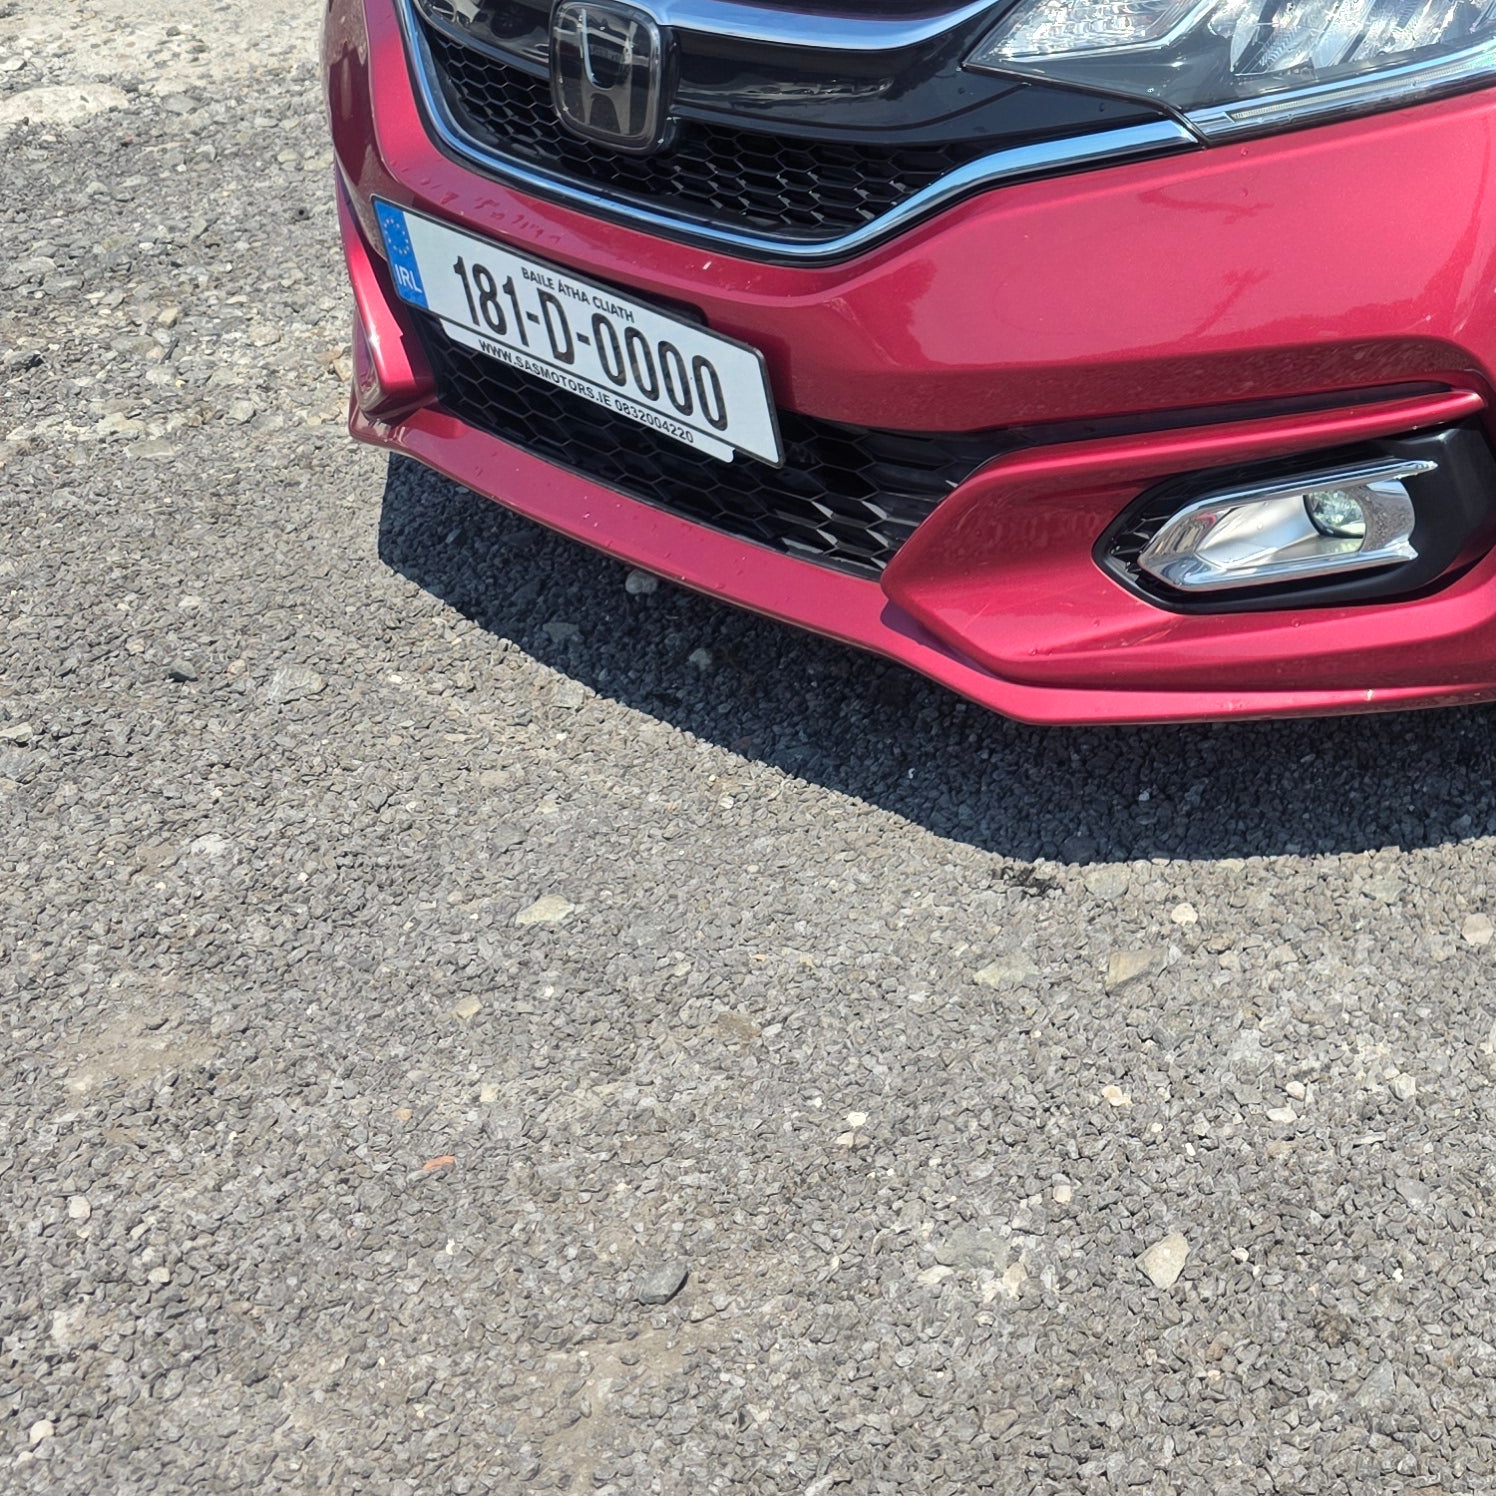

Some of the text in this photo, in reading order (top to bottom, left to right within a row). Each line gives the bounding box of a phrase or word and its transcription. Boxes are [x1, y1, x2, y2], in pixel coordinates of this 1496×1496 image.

[394, 263, 423, 294] IRL
[521, 266, 556, 291] BAILE
[591, 295, 635, 324] CLIATH
[453, 255, 729, 432] 181-D-0000
[477, 338, 613, 408] WWW.SASMOTORS.IE
